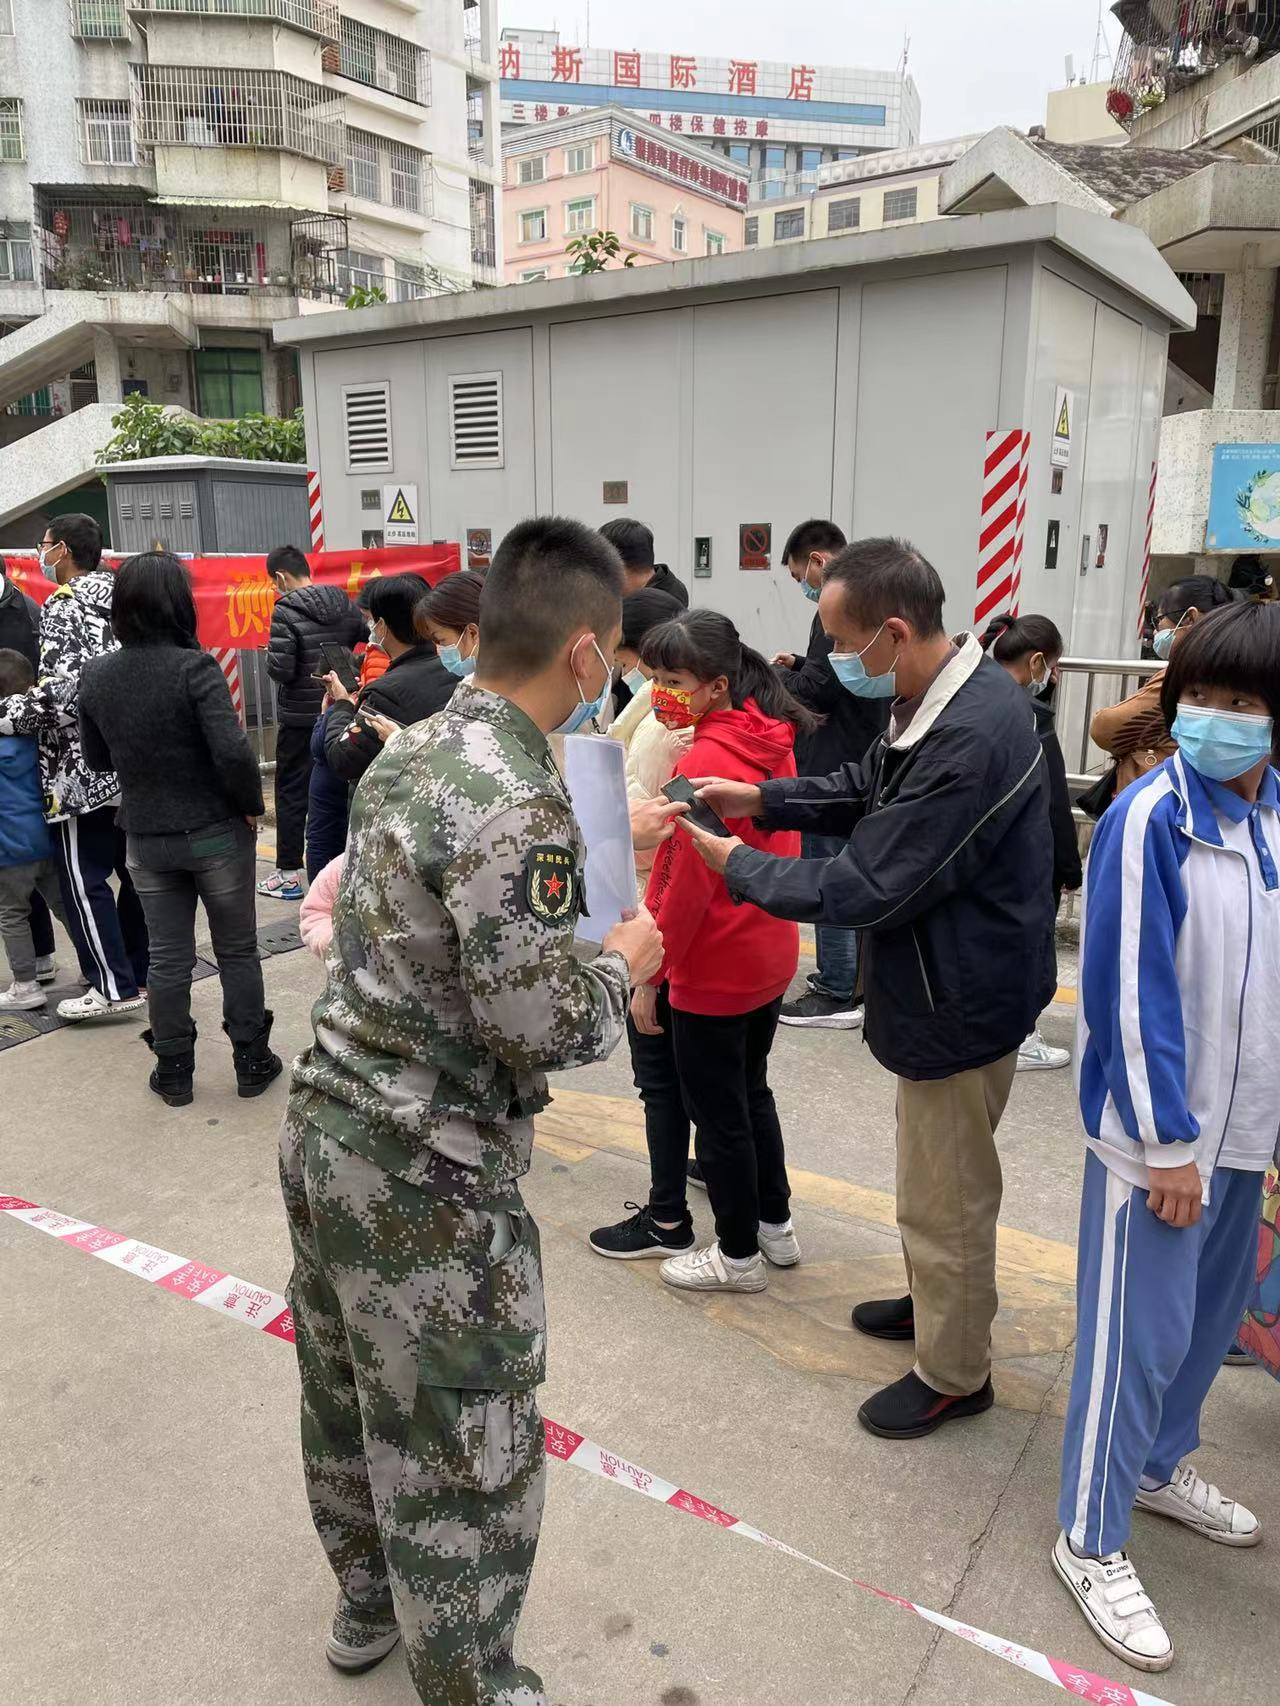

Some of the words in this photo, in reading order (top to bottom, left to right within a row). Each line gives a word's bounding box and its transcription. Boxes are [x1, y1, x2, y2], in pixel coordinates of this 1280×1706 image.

[512, 103, 588, 121] 三楼影
[87, 771, 118, 797] PLEAS
[87, 781, 120, 806] PLEAS
[172, 1272, 201, 1294] 安全
[186, 1264, 218, 1283] SAFE
[233, 1283, 272, 1305] CAUTION
[223, 1292, 263, 1319] 注意
[280, 1315, 295, 1333] 全
[546, 1425, 576, 1446] SAF
[550, 1436, 568, 1456] 安
[600, 1450, 653, 1484] CAUTION
[600, 1459, 649, 1492] 注意
